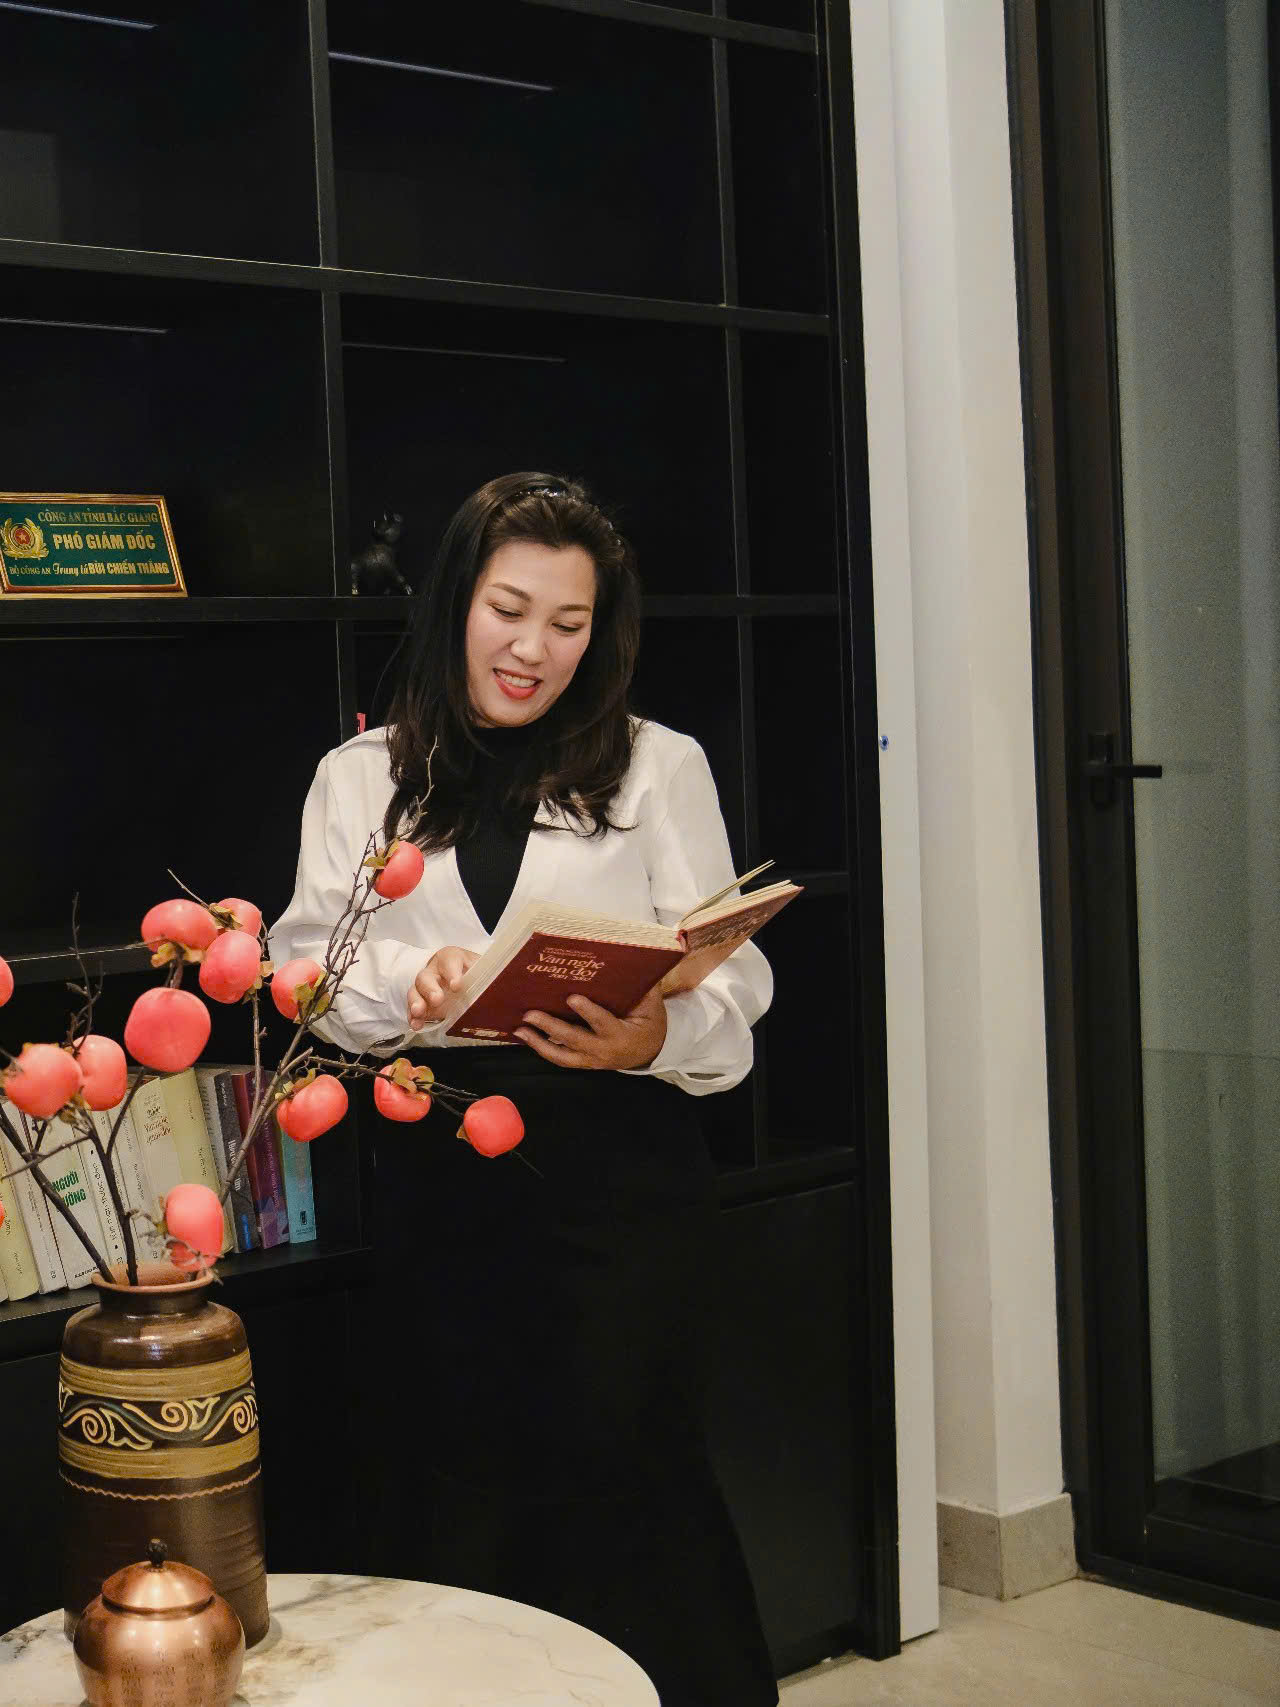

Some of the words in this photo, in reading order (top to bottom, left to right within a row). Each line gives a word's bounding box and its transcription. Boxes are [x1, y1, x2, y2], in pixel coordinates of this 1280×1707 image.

[38, 508, 69, 523] CÔNG
[69, 512, 82, 523] AN
[128, 512, 159, 523] GIANG
[52, 530, 84, 550] PHÓ
[85, 530, 125, 550] GIÁM
